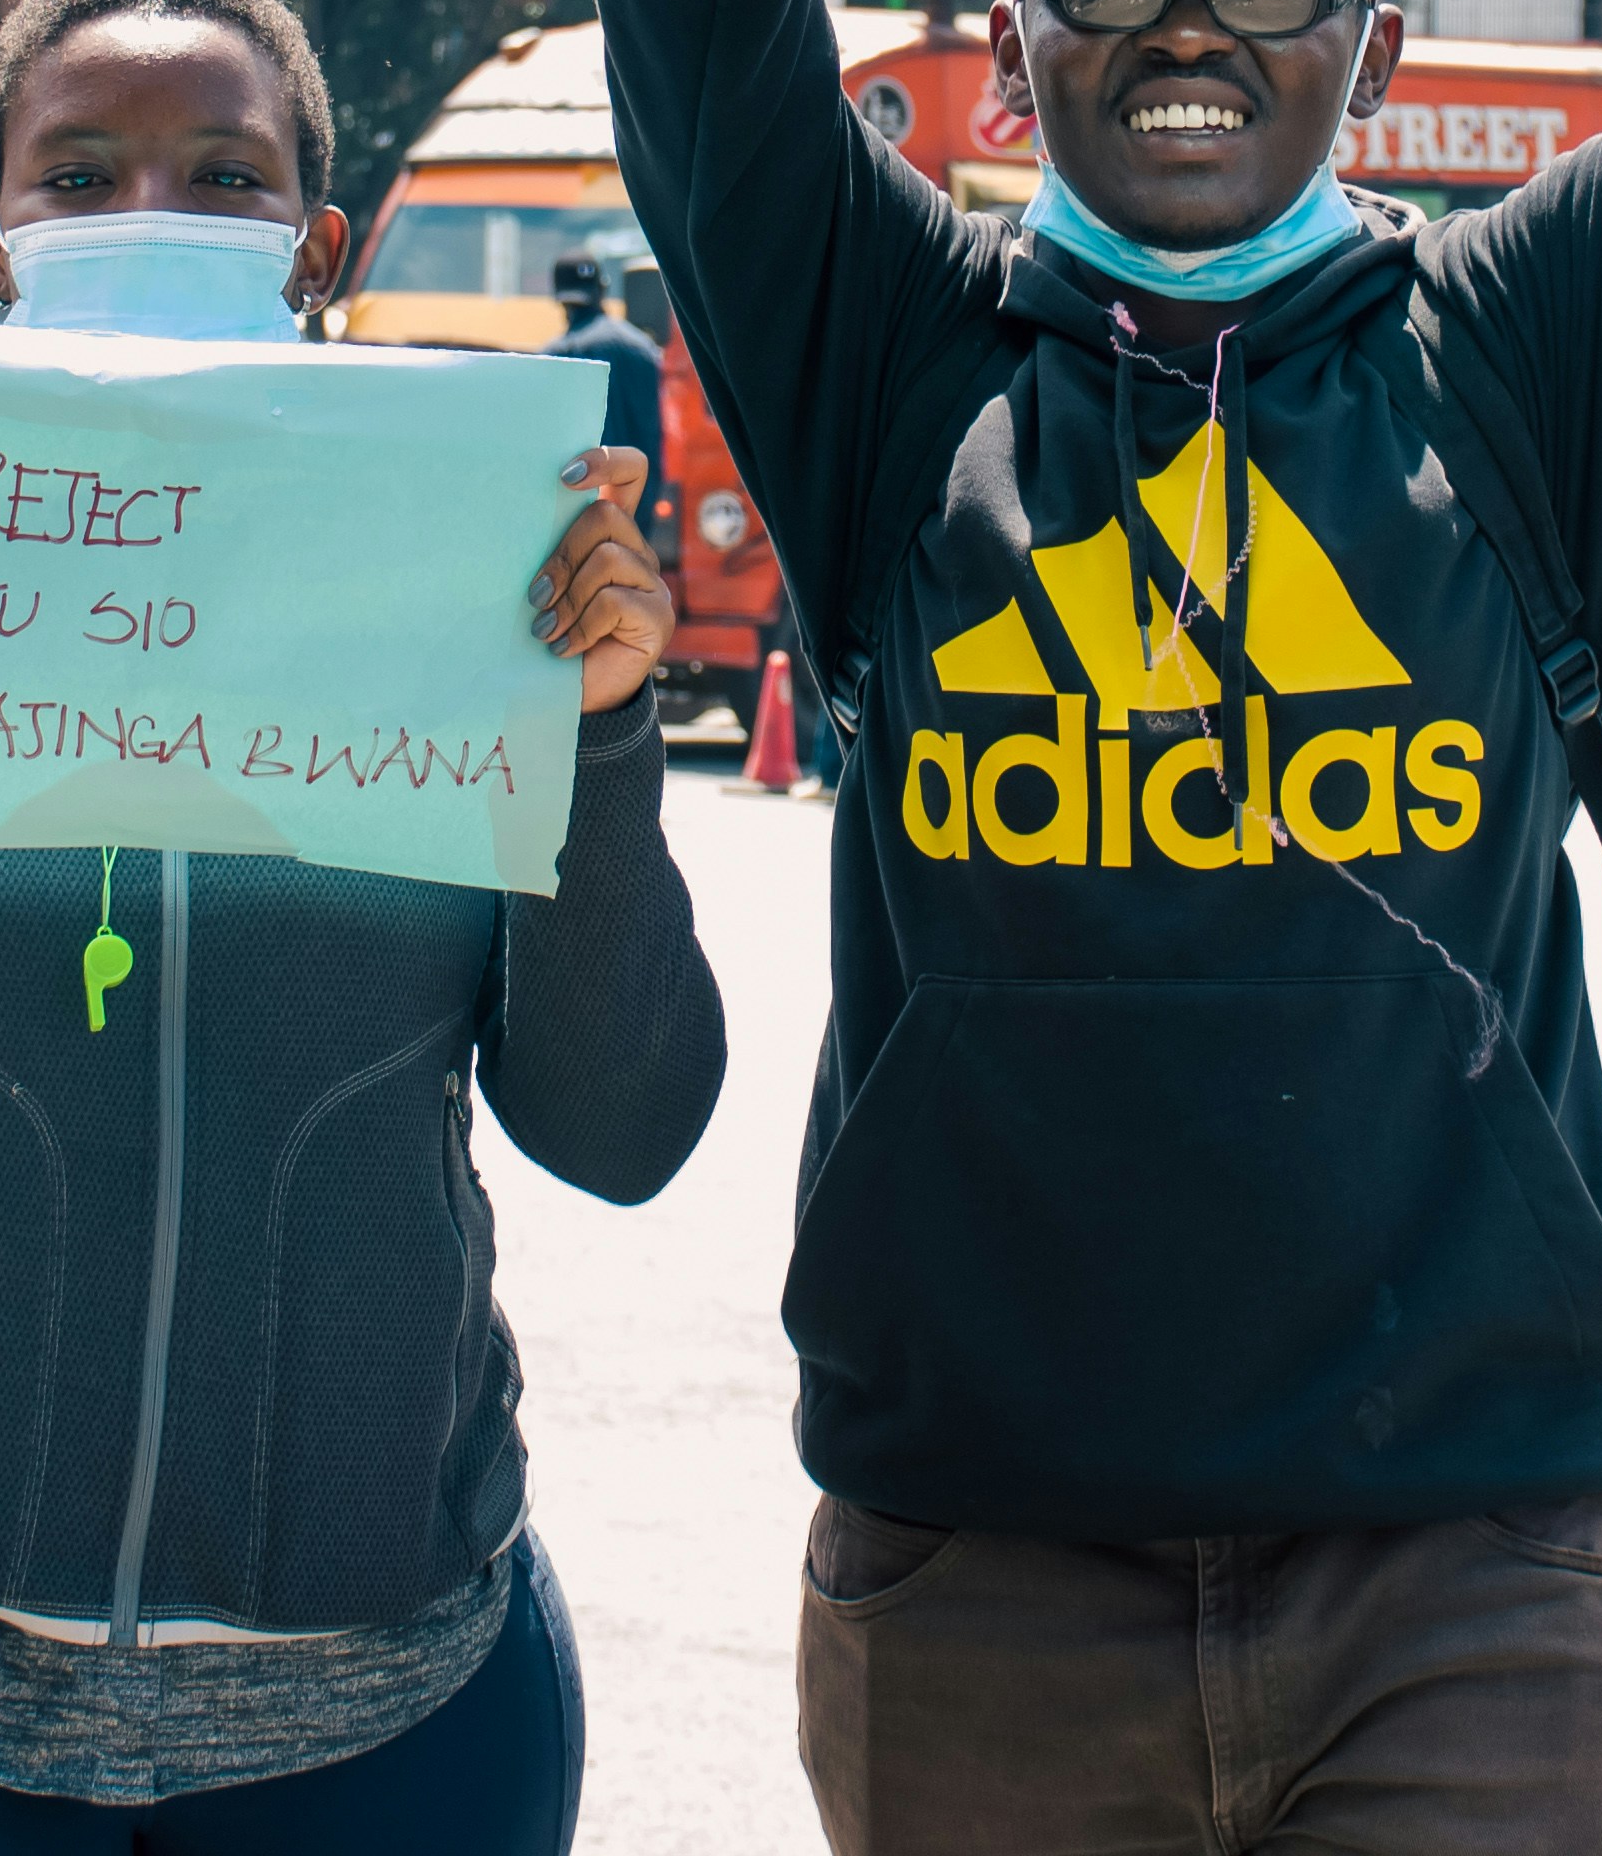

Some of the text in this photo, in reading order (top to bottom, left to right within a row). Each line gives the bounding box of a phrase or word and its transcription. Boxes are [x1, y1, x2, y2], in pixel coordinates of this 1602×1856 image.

[1334, 102, 1568, 173] STREET
[237, 724, 516, 797] BWANA
[902, 693, 1485, 869] adidas
